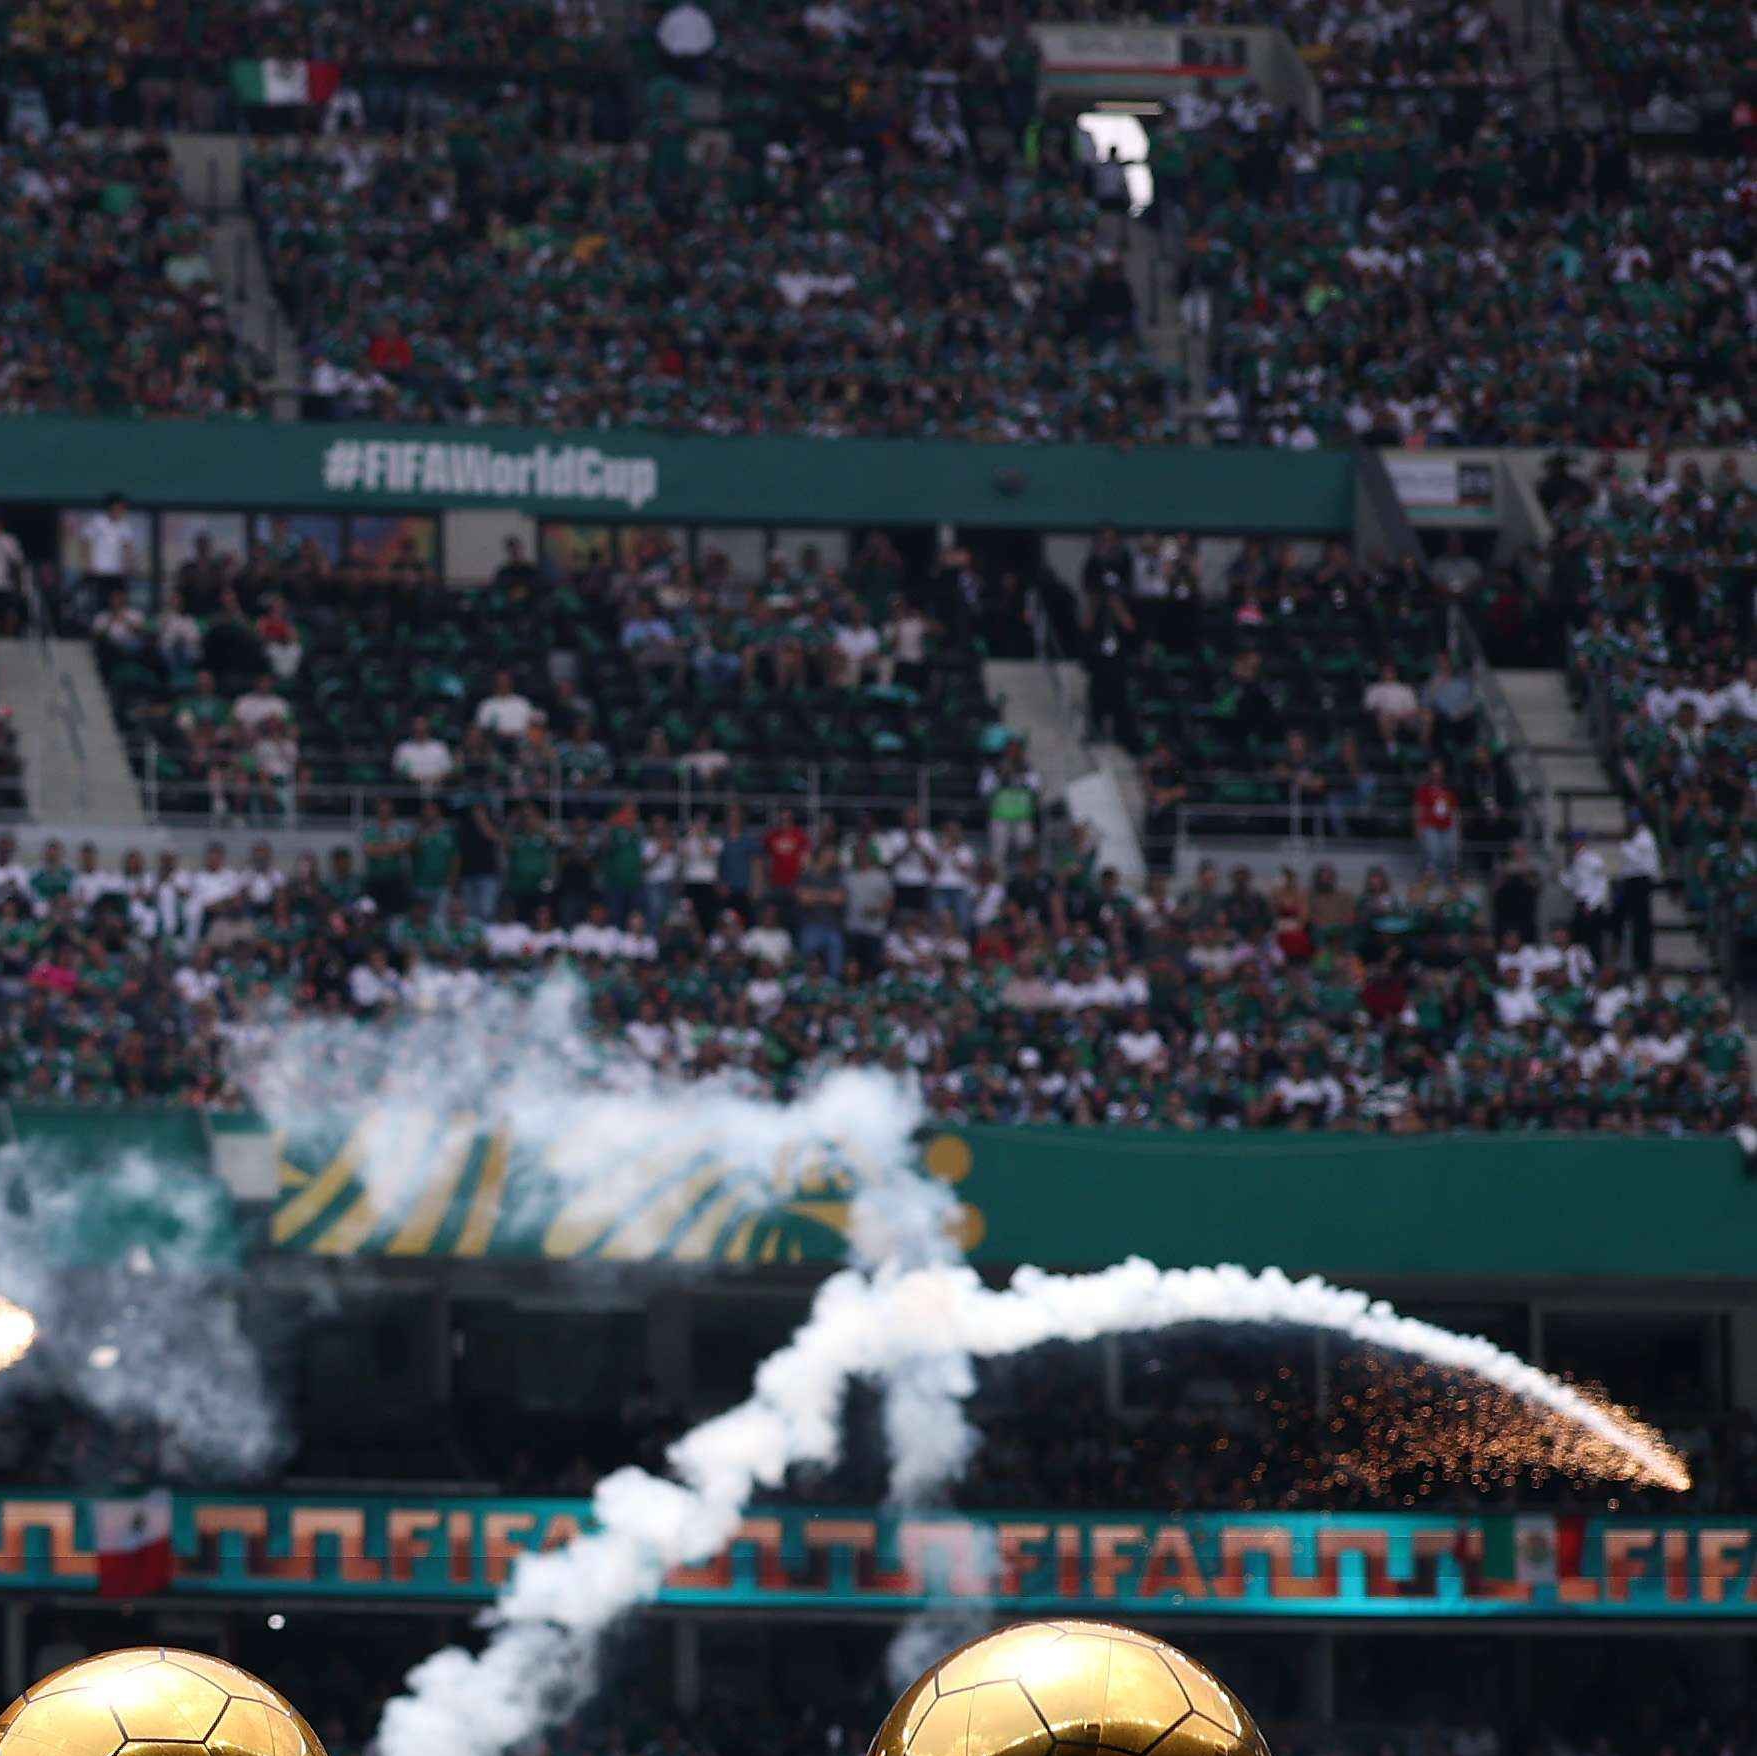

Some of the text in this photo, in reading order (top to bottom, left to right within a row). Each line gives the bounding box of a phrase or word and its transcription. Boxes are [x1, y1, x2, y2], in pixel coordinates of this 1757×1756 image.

[323, 438, 657, 510] #FIFAWorldCup
[998, 1524, 1209, 1599] FIFA
[1603, 1529, 1757, 1603] FIF
